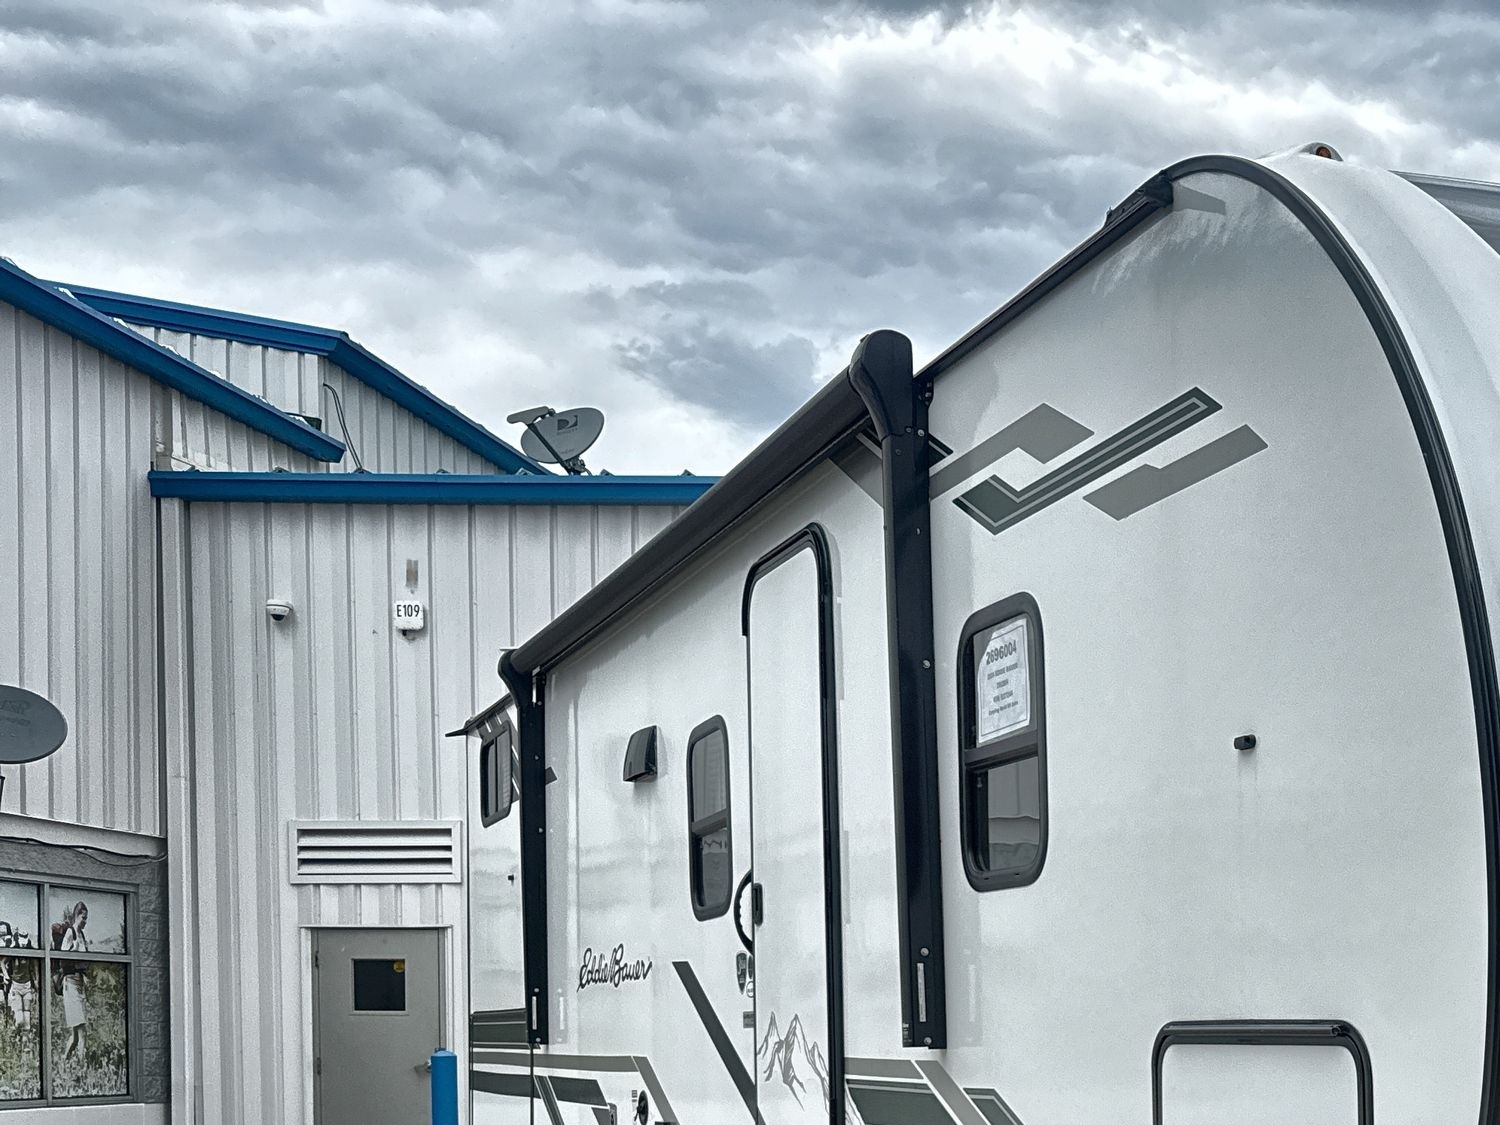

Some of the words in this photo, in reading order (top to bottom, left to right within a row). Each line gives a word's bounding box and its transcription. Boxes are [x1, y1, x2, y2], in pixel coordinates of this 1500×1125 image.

[396, 604, 420, 618] E109
[986, 640, 1017, 665] 2696004
[577, 947, 609, 993] Eddie
[609, 943, 652, 988] Bauer
